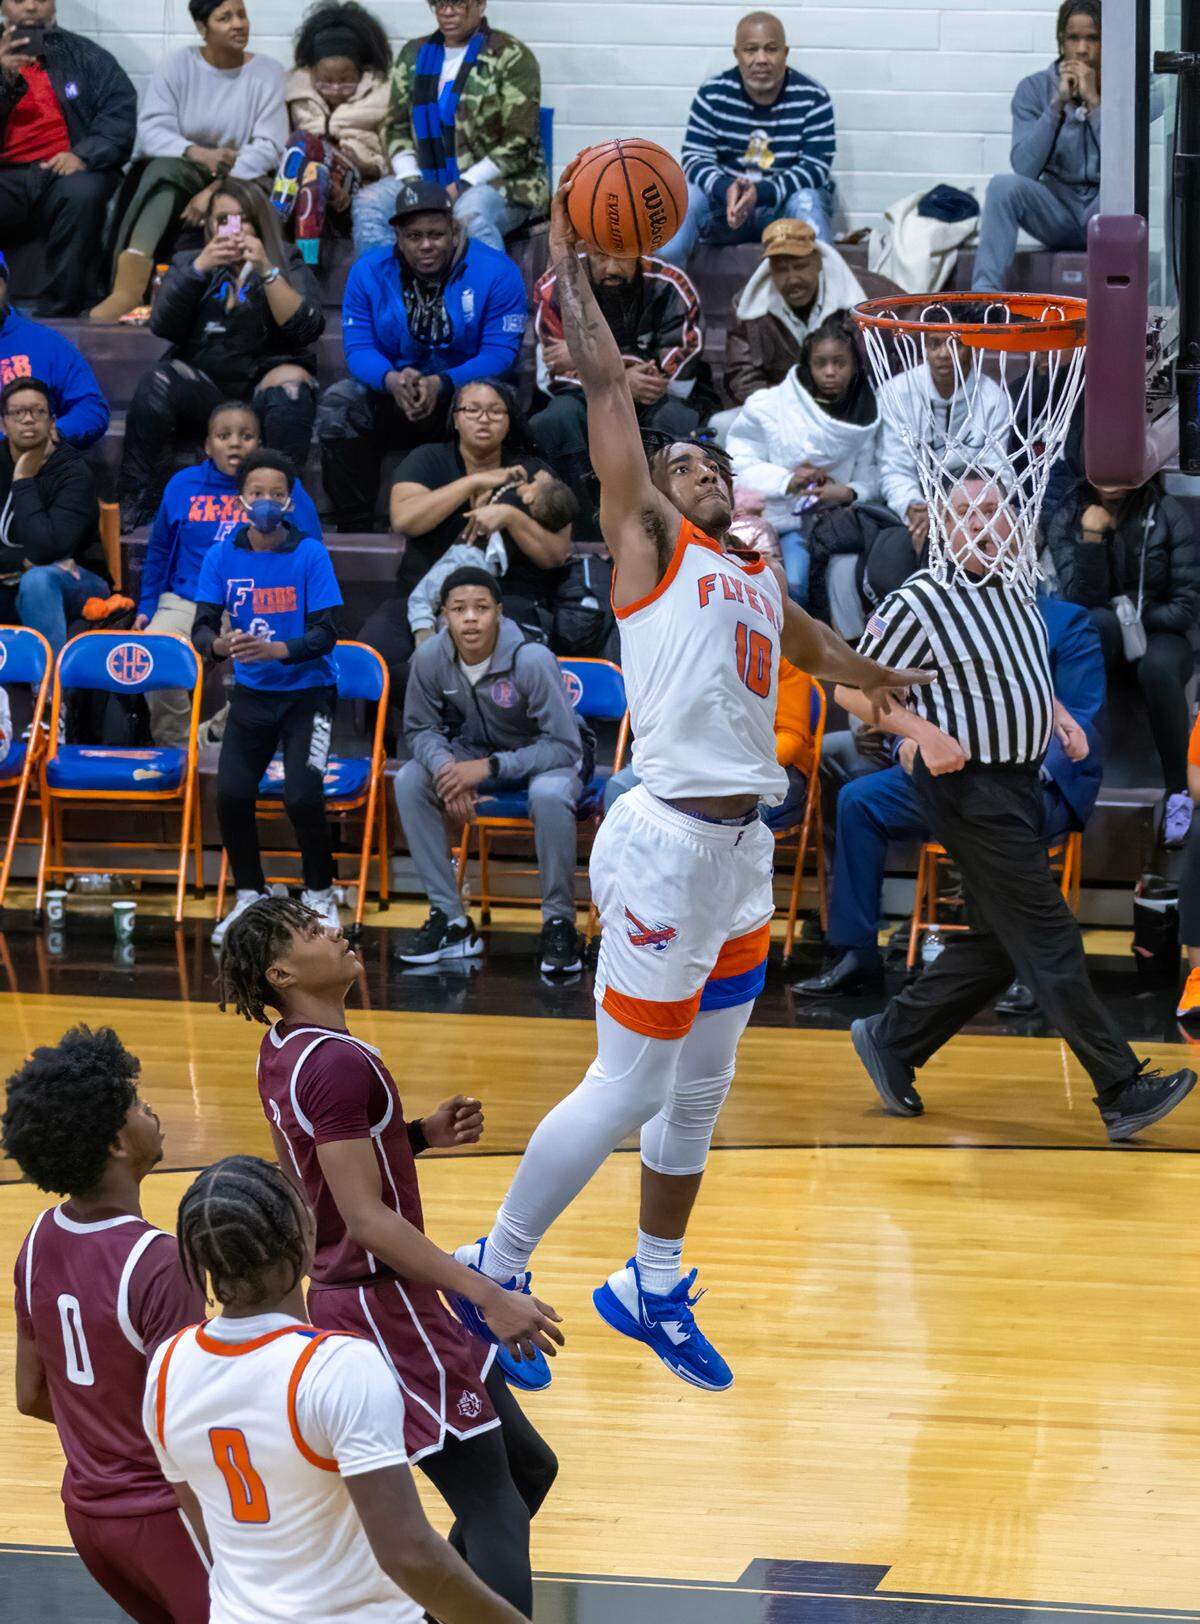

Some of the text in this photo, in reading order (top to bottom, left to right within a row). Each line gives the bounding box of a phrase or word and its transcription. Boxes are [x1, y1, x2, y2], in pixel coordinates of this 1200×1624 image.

[641, 182, 668, 251] Wilso
[735, 620, 773, 699] 10
[57, 1293, 95, 1386] 0
[208, 1426, 270, 1524] 0
